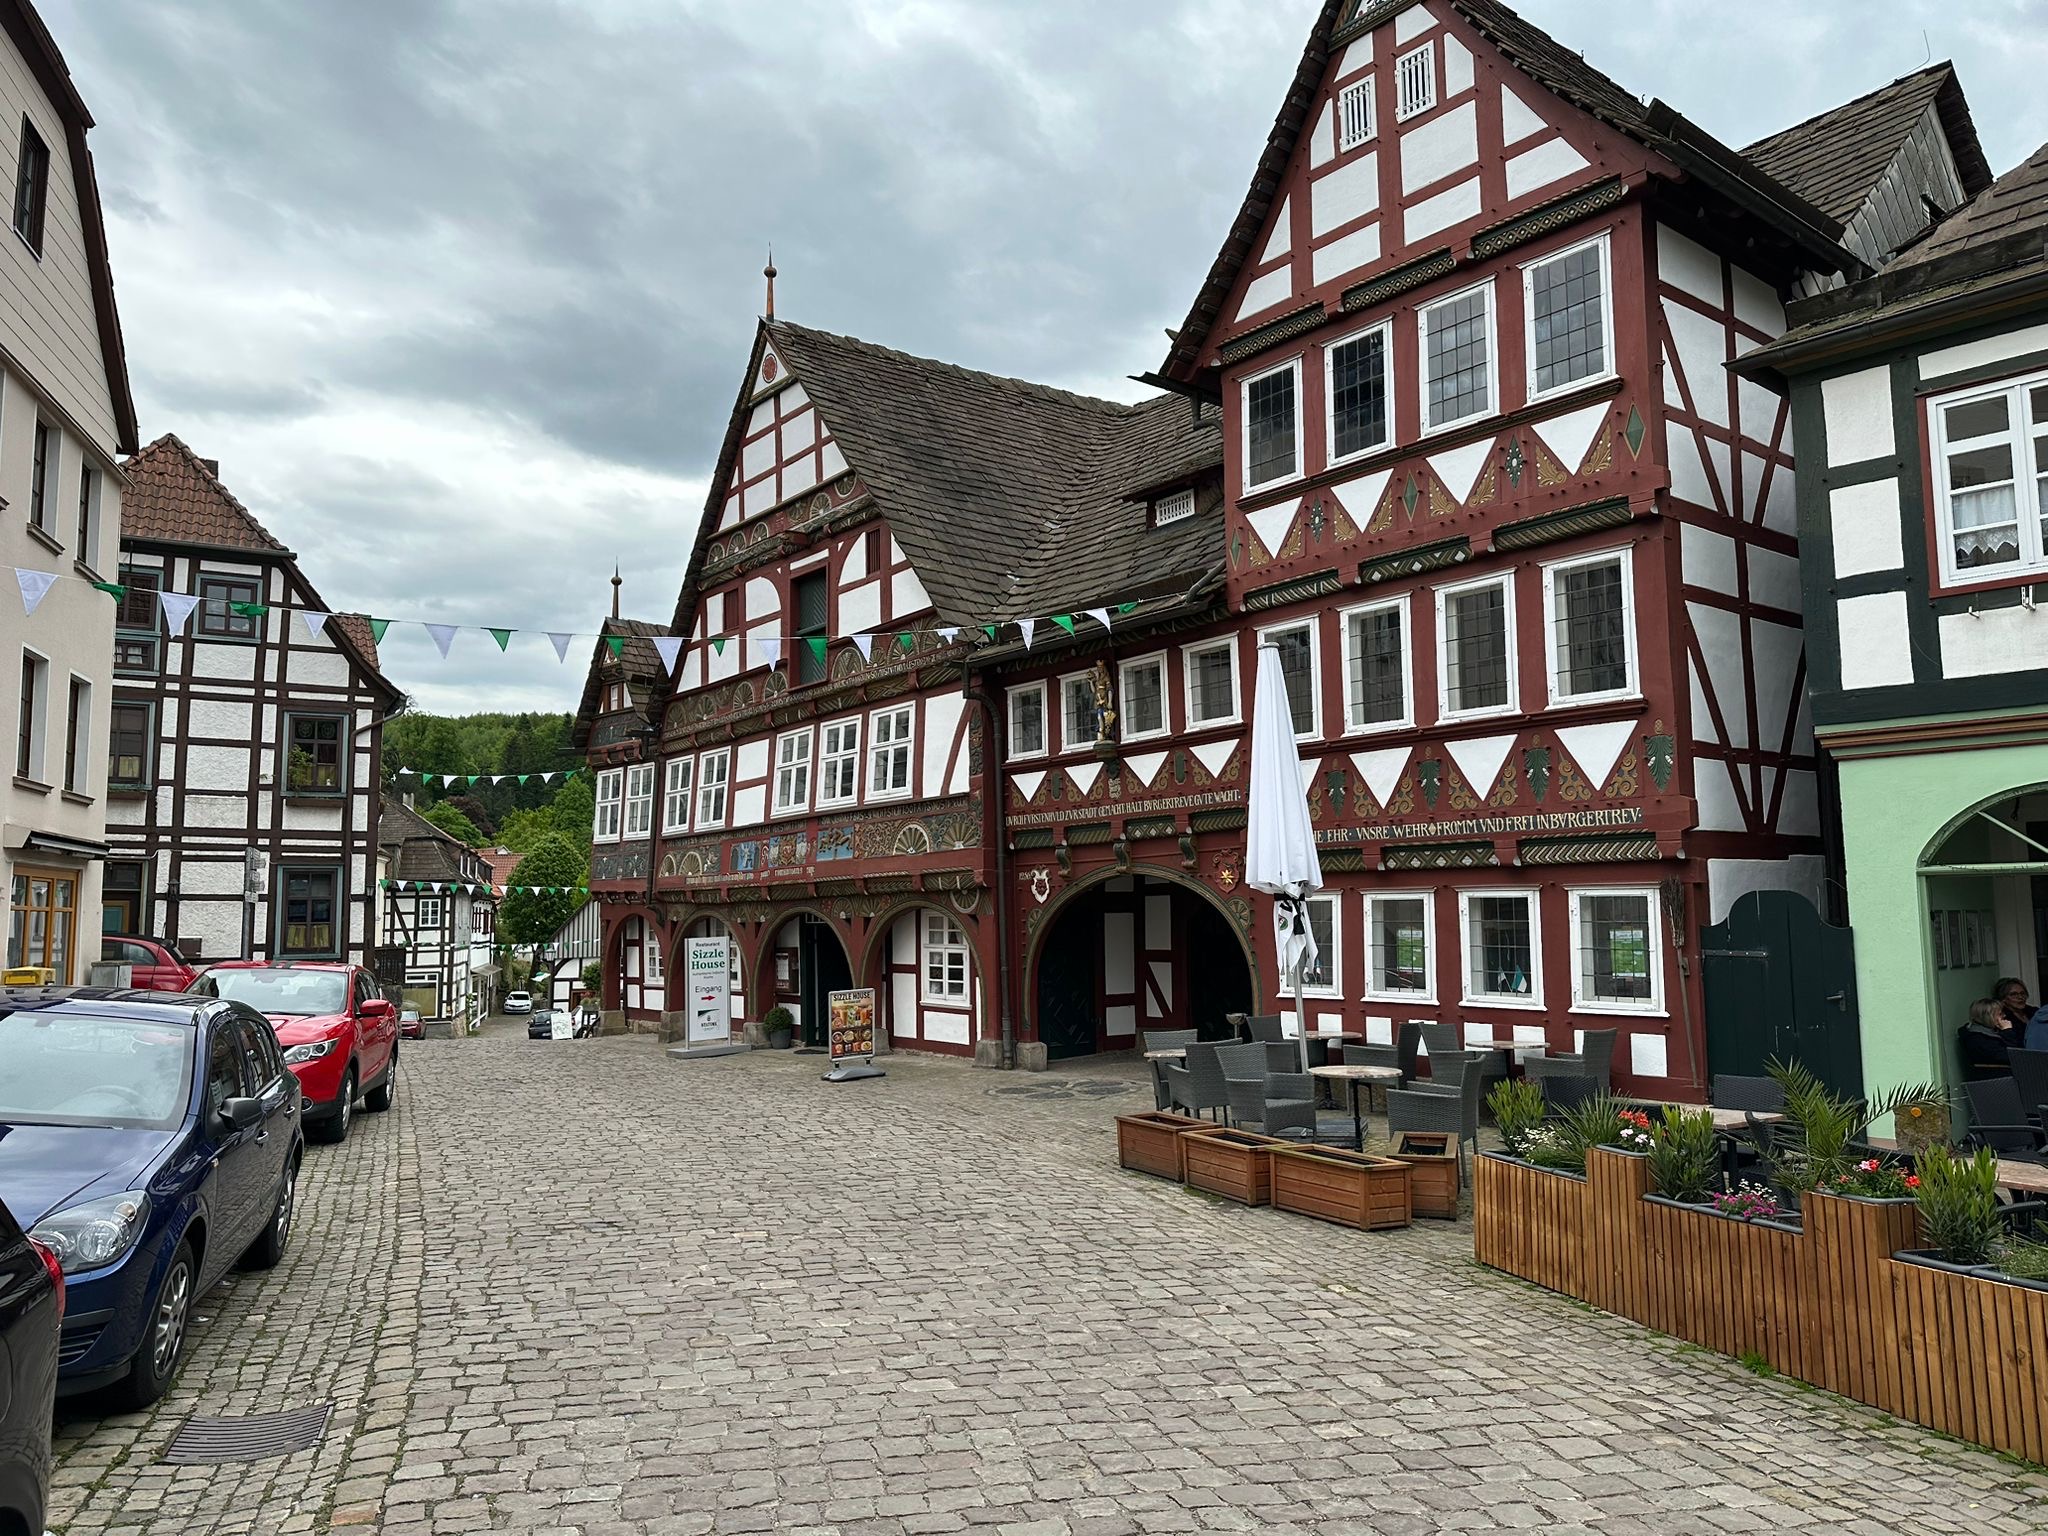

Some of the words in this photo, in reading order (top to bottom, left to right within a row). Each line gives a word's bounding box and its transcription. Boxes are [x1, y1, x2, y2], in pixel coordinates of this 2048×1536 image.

[1392, 822, 1429, 838] WEHR
[1437, 819, 1478, 835] FROMM
[692, 948, 724, 959] Sizzle
[691, 960, 725, 970] House
[695, 985, 722, 993] Eingang
[833, 993, 852, 1001] SIZZLE
[853, 991, 870, 1000] HOUSE
